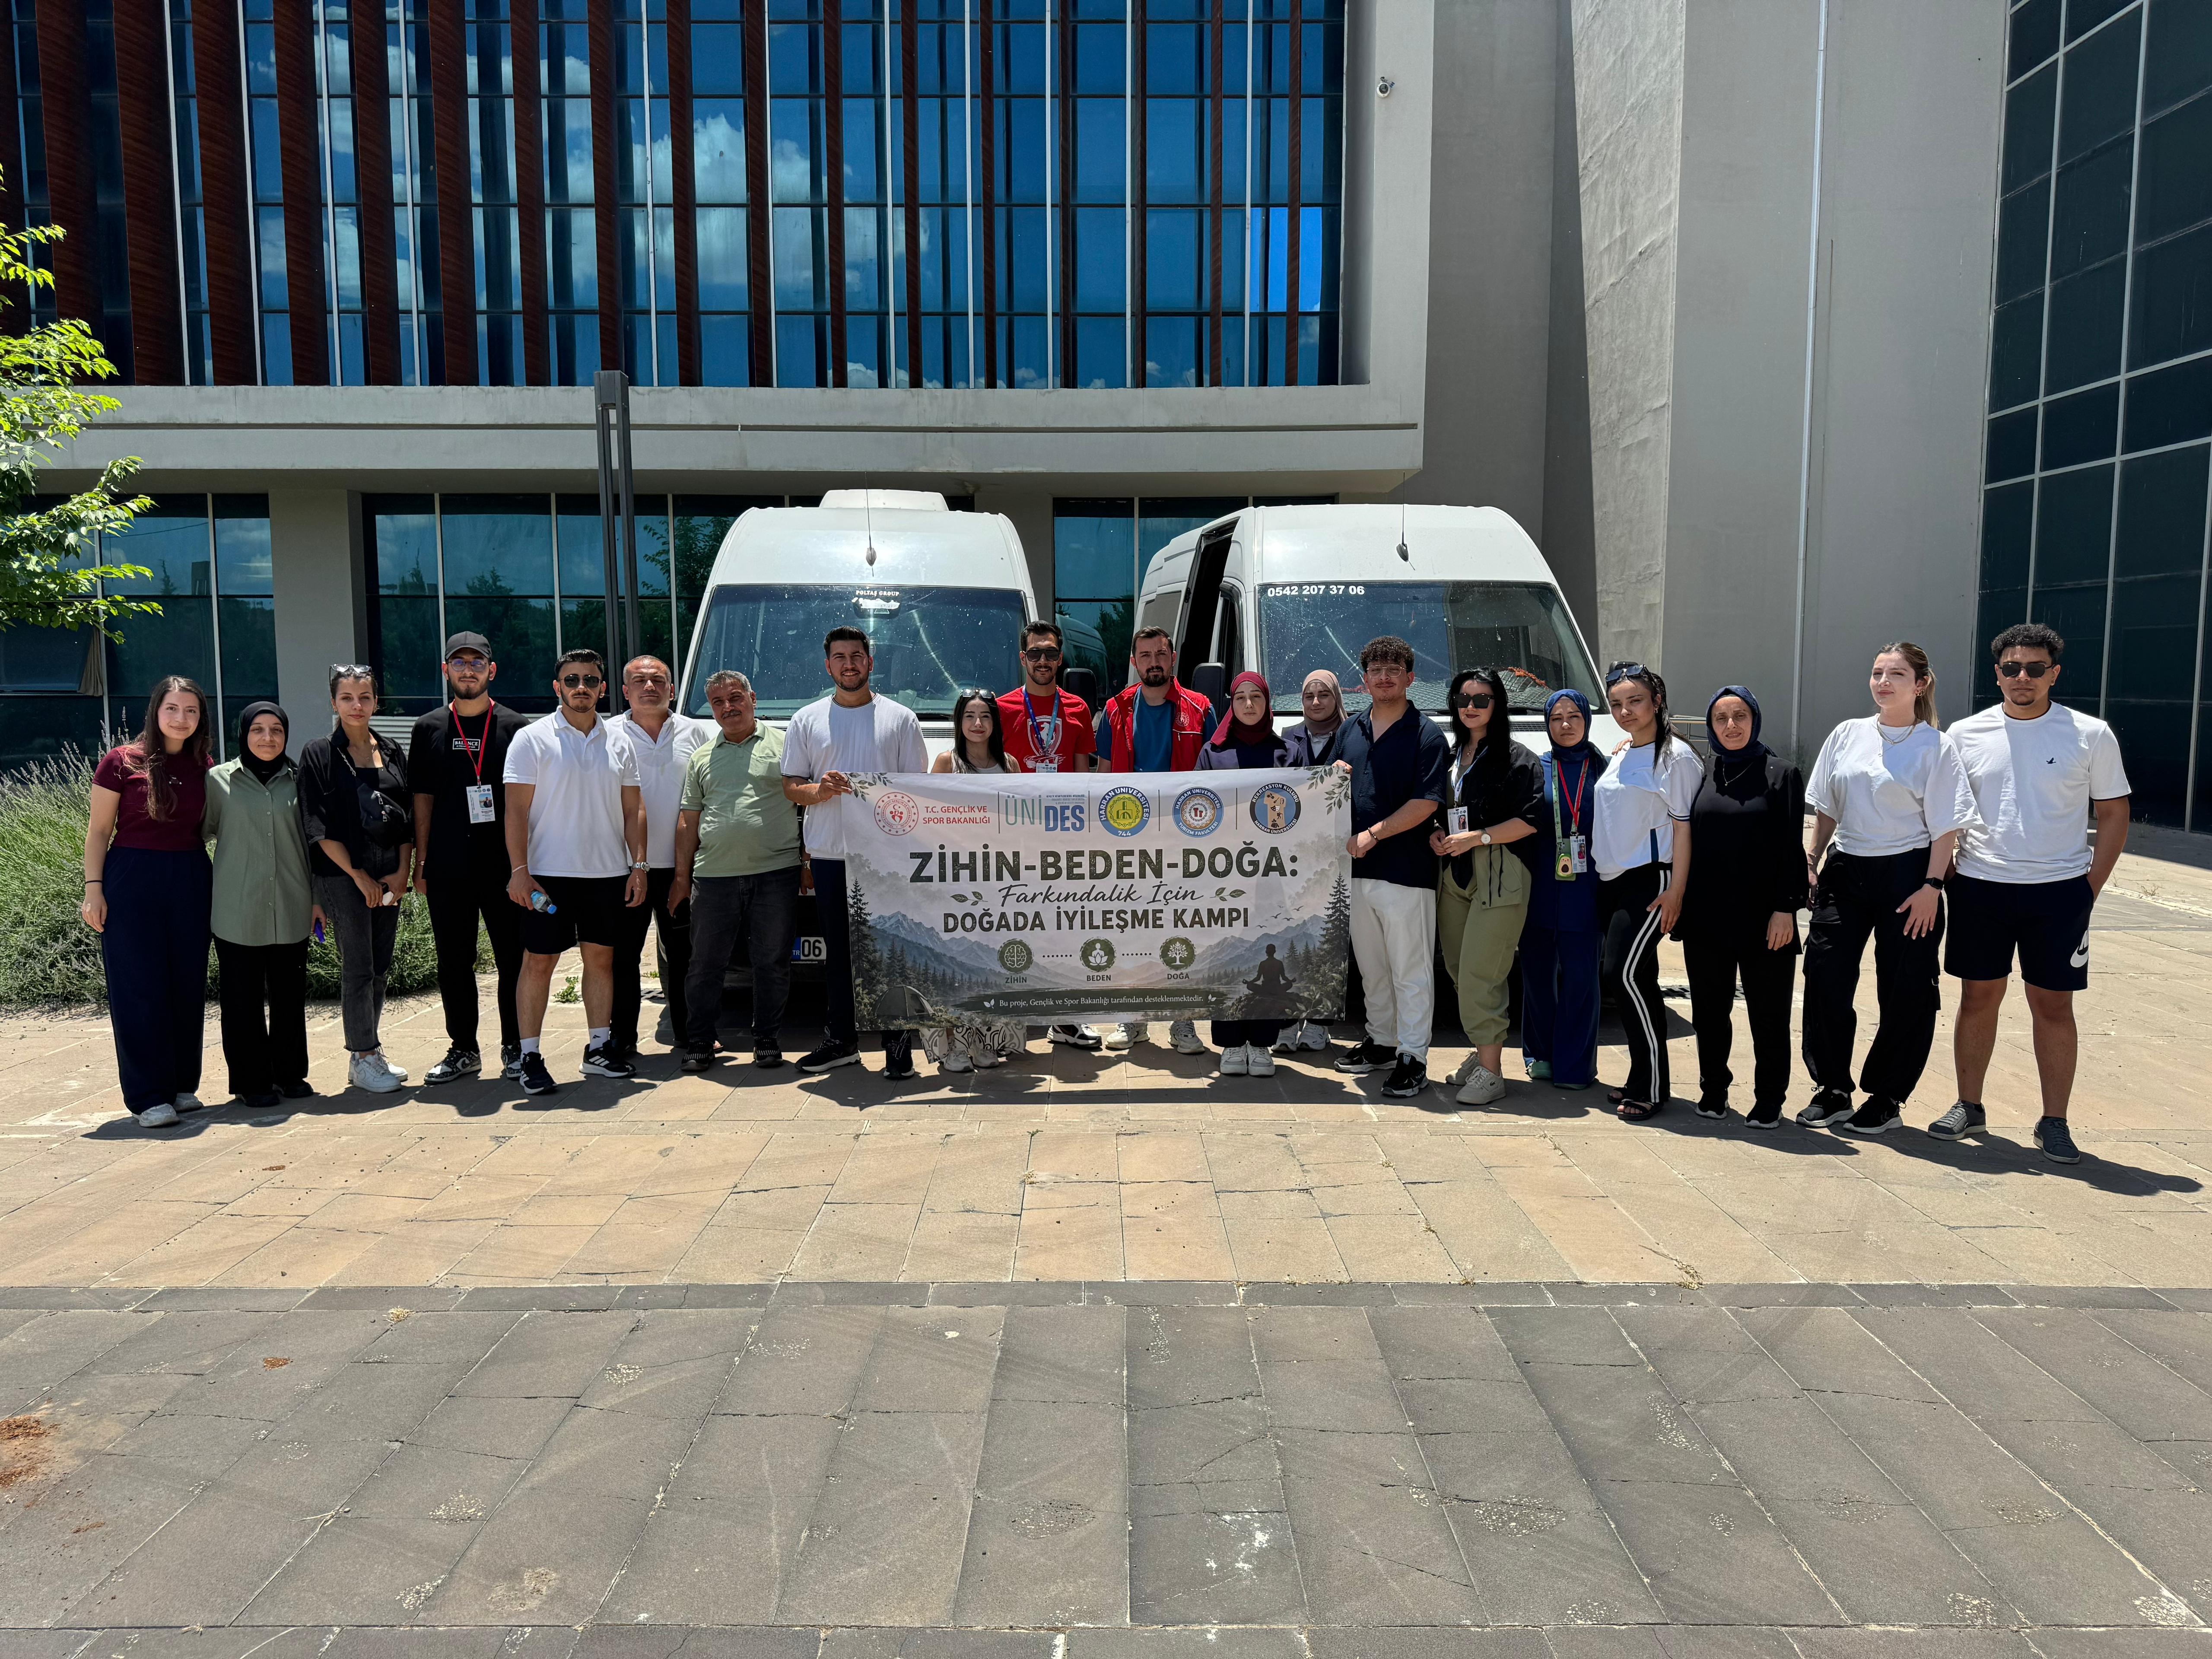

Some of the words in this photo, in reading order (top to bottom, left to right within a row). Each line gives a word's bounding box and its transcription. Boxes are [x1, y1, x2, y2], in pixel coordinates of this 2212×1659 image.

[1267, 586, 1298, 597] 0542
[1302, 585, 1325, 594] 207
[1329, 585, 1345, 594] 37
[1348, 585, 1365, 595] 06
[1175, 791, 1191, 809] HARRAN
[1252, 783, 1282, 803] REKREASYON
[941, 804, 976, 814] GENÇLİK
[1100, 791, 1115, 820] HARRAN
[946, 816, 990, 824] BAKANLIĞI
[1254, 820, 1270, 833] HARRAN
[909, 840, 1298, 883] ZİHİN-BEDEN-DOĞA:
[1146, 880, 1204, 906] İçin
[943, 908, 1046, 933] DOĞADA
[1056, 906, 1164, 933] İYİLEŞME
[1173, 907, 1249, 928] KAMPI
[801, 939, 822, 957] 06
[1167, 972, 1190, 980] DOĞA
[1010, 999, 1028, 1008] proje,
[1064, 998, 1079, 1006] Spor
[1081, 997, 1109, 1006] Bakanlığı
